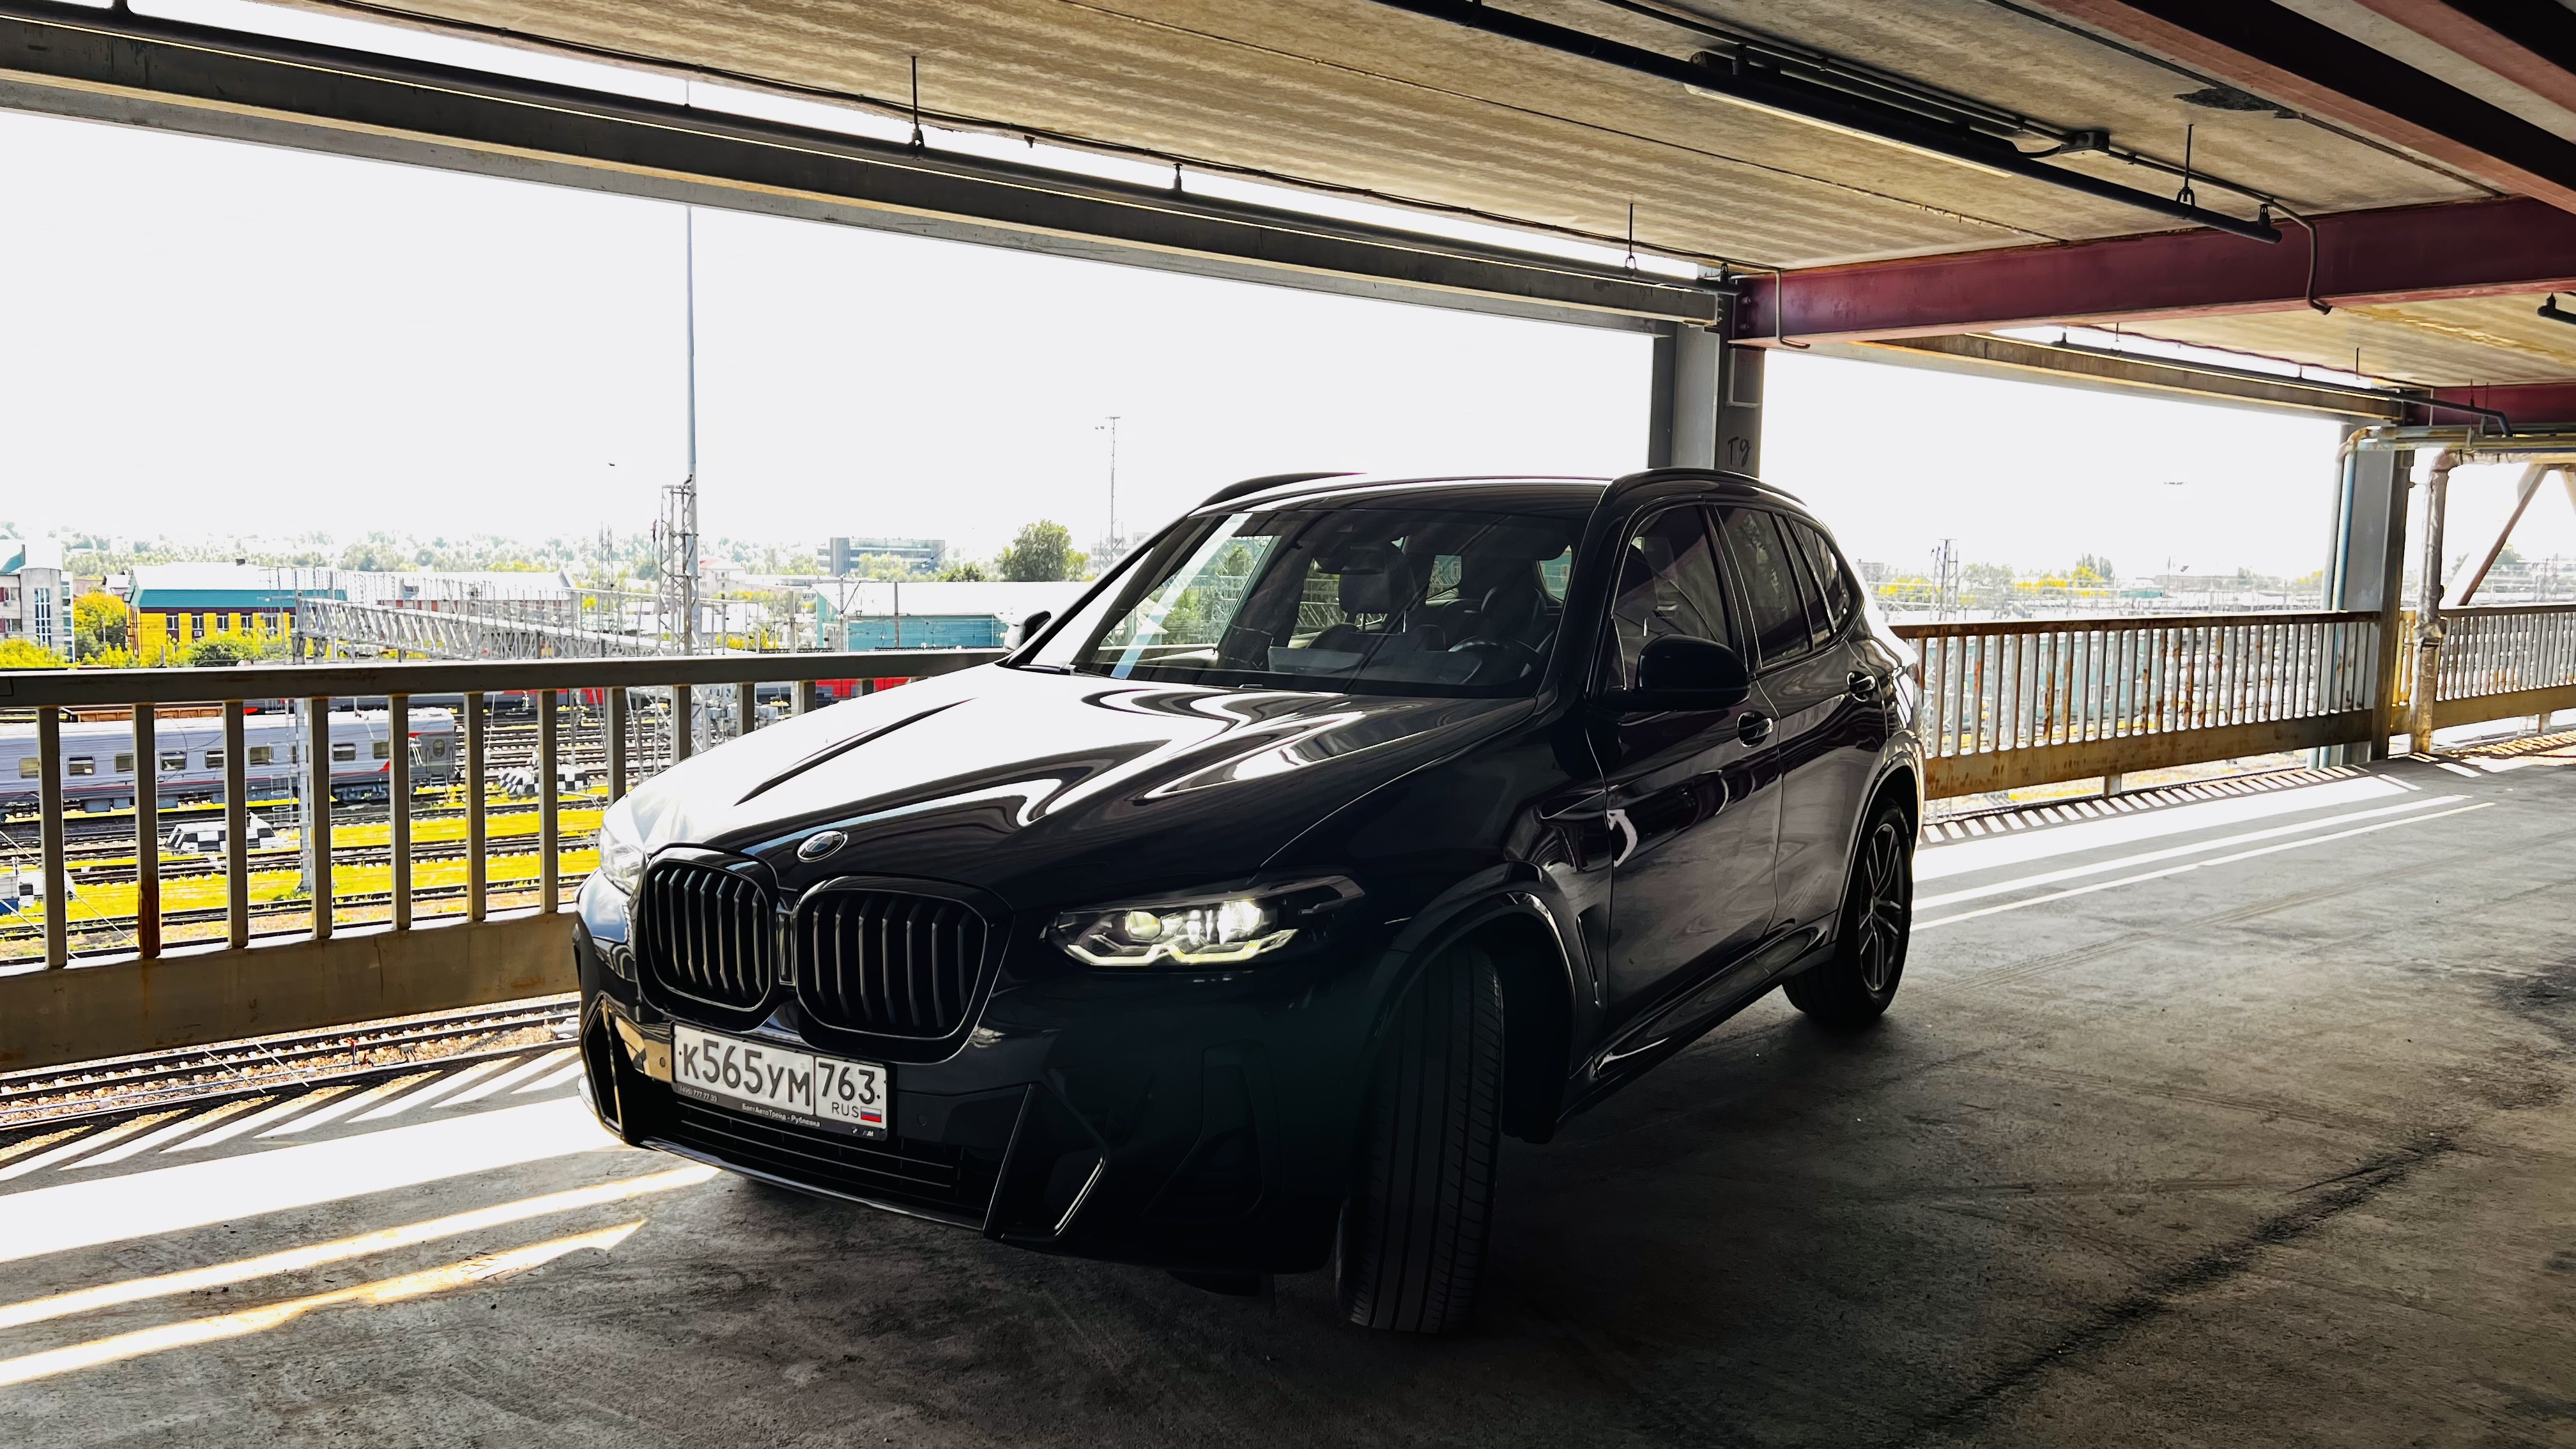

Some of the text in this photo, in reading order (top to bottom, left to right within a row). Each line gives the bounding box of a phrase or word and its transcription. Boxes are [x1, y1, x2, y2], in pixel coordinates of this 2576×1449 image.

[683, 1039, 875, 1106] К565УМ 763
[832, 1102, 859, 1117] RUS
